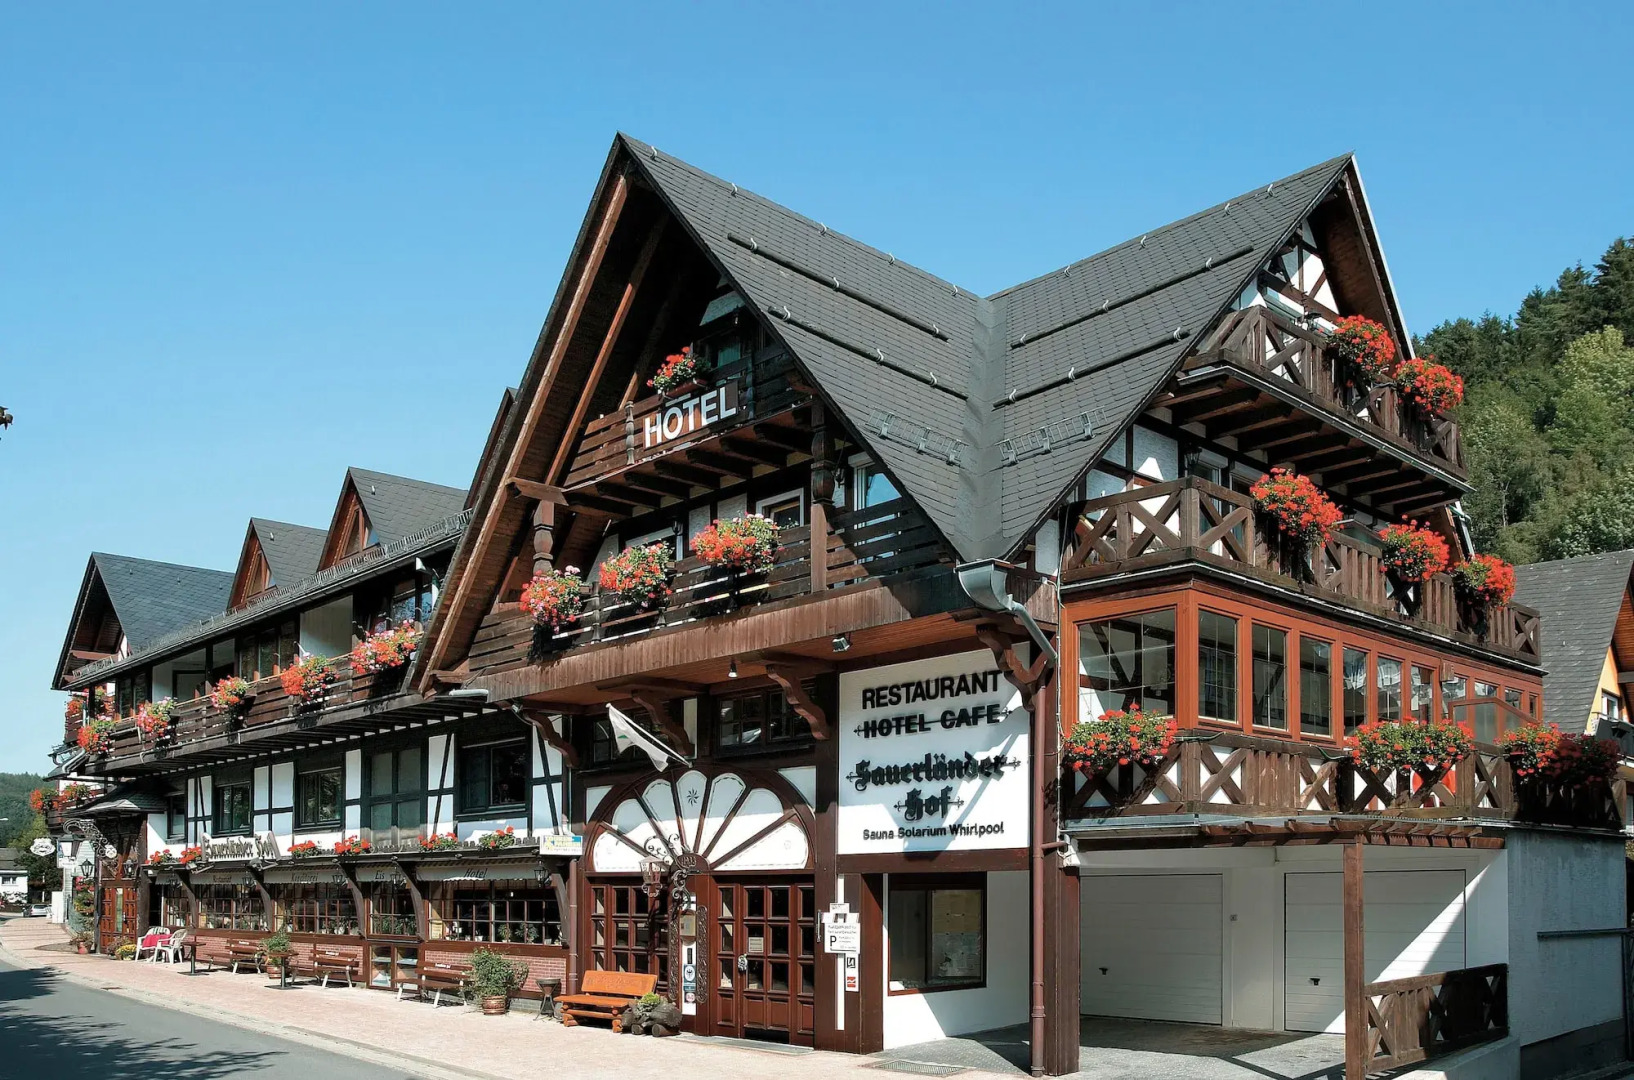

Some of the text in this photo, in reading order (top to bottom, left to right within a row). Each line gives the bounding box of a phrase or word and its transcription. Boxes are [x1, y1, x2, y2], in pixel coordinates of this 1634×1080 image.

[644, 386, 737, 449] HOTEL
[862, 670, 1003, 709] RESTAURANT
[863, 704, 1000, 739] HOTEL CAFE
[855, 751, 1008, 791] Sauerländer
[904, 786, 953, 821] Hof
[863, 821, 1004, 840] Sauna Solarium Whirlpool
[375, 869, 385, 880] Eis
[463, 867, 488, 880] Hotel
[829, 935, 837, 947] P
